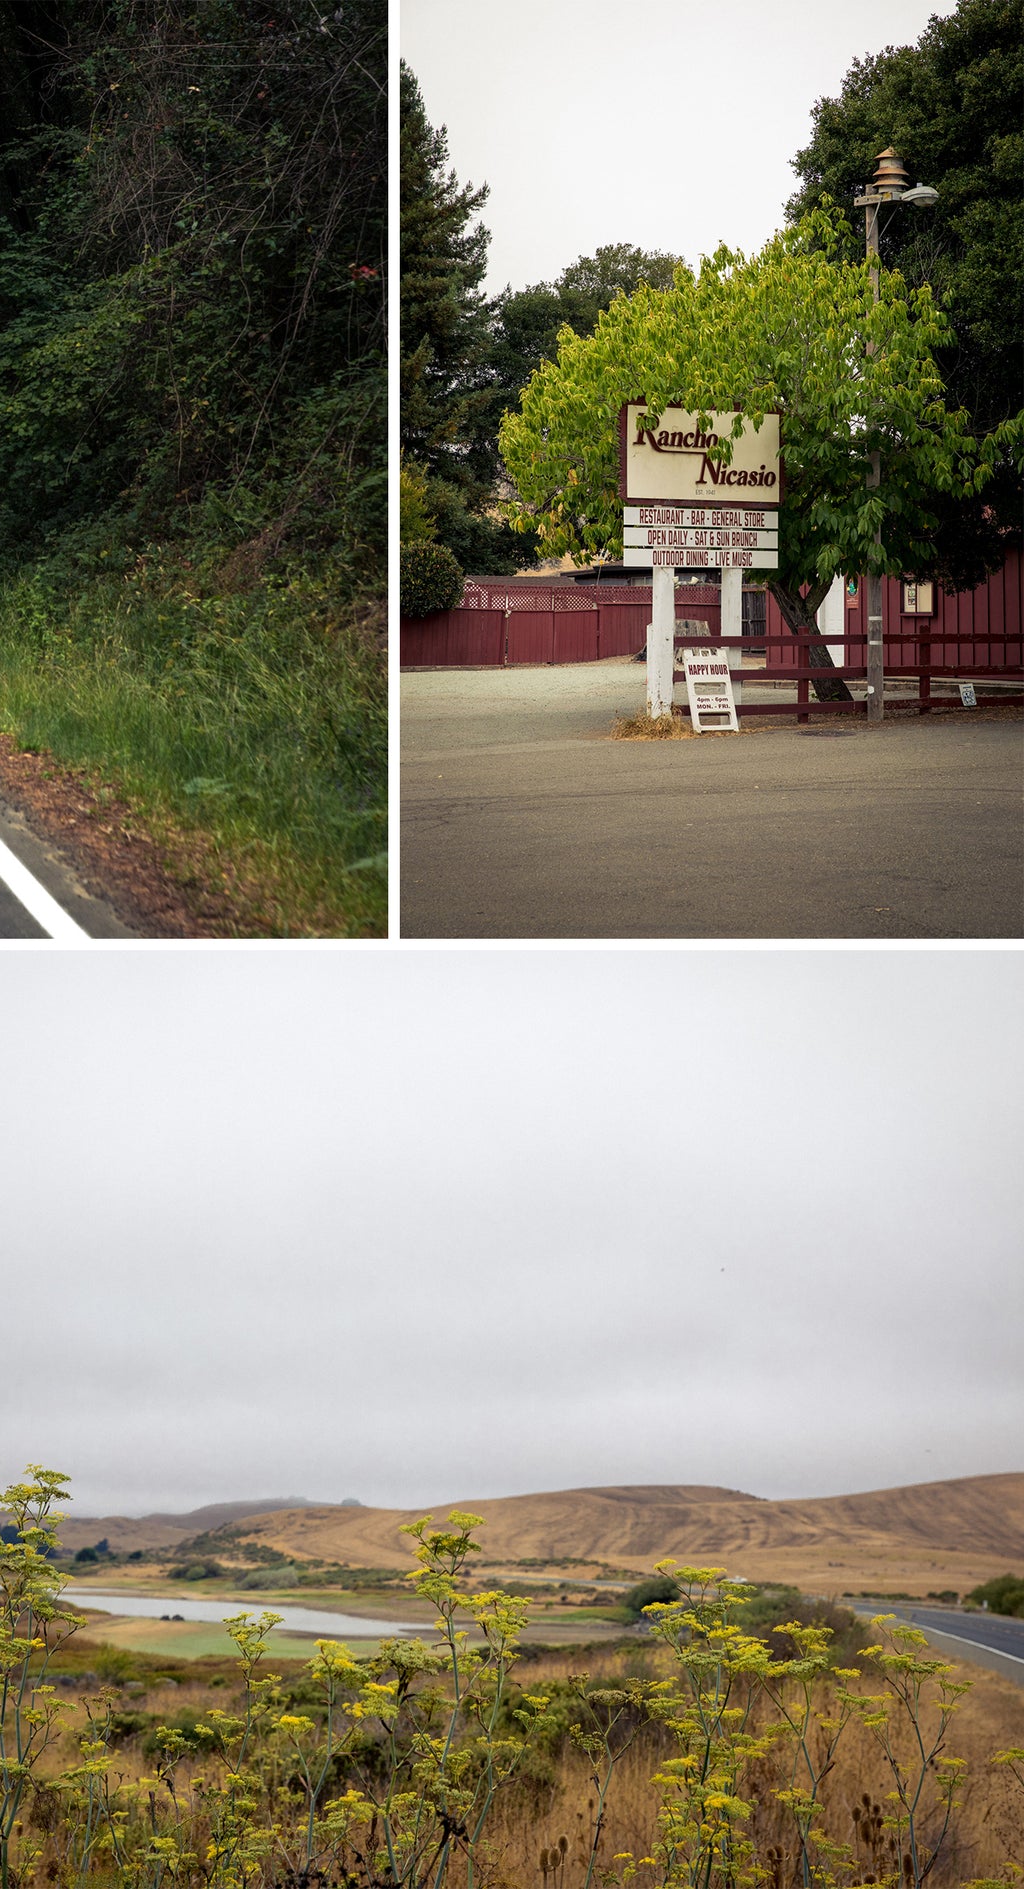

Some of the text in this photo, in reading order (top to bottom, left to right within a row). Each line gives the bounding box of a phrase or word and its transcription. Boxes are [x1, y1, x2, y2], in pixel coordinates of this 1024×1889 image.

[633, 413, 719, 452] Rancho
[696, 454, 777, 487] Nicasio
[639, 508, 765, 527] RESTAURANT BAR GENERAL STORE
[647, 530, 758, 547] OPEN DAILY SAT & SUN BRUNCH
[652, 550, 753, 567] OUTDOOR DINING LIVE MUSIC
[688, 664, 728, 675] HAPPY HOUR
